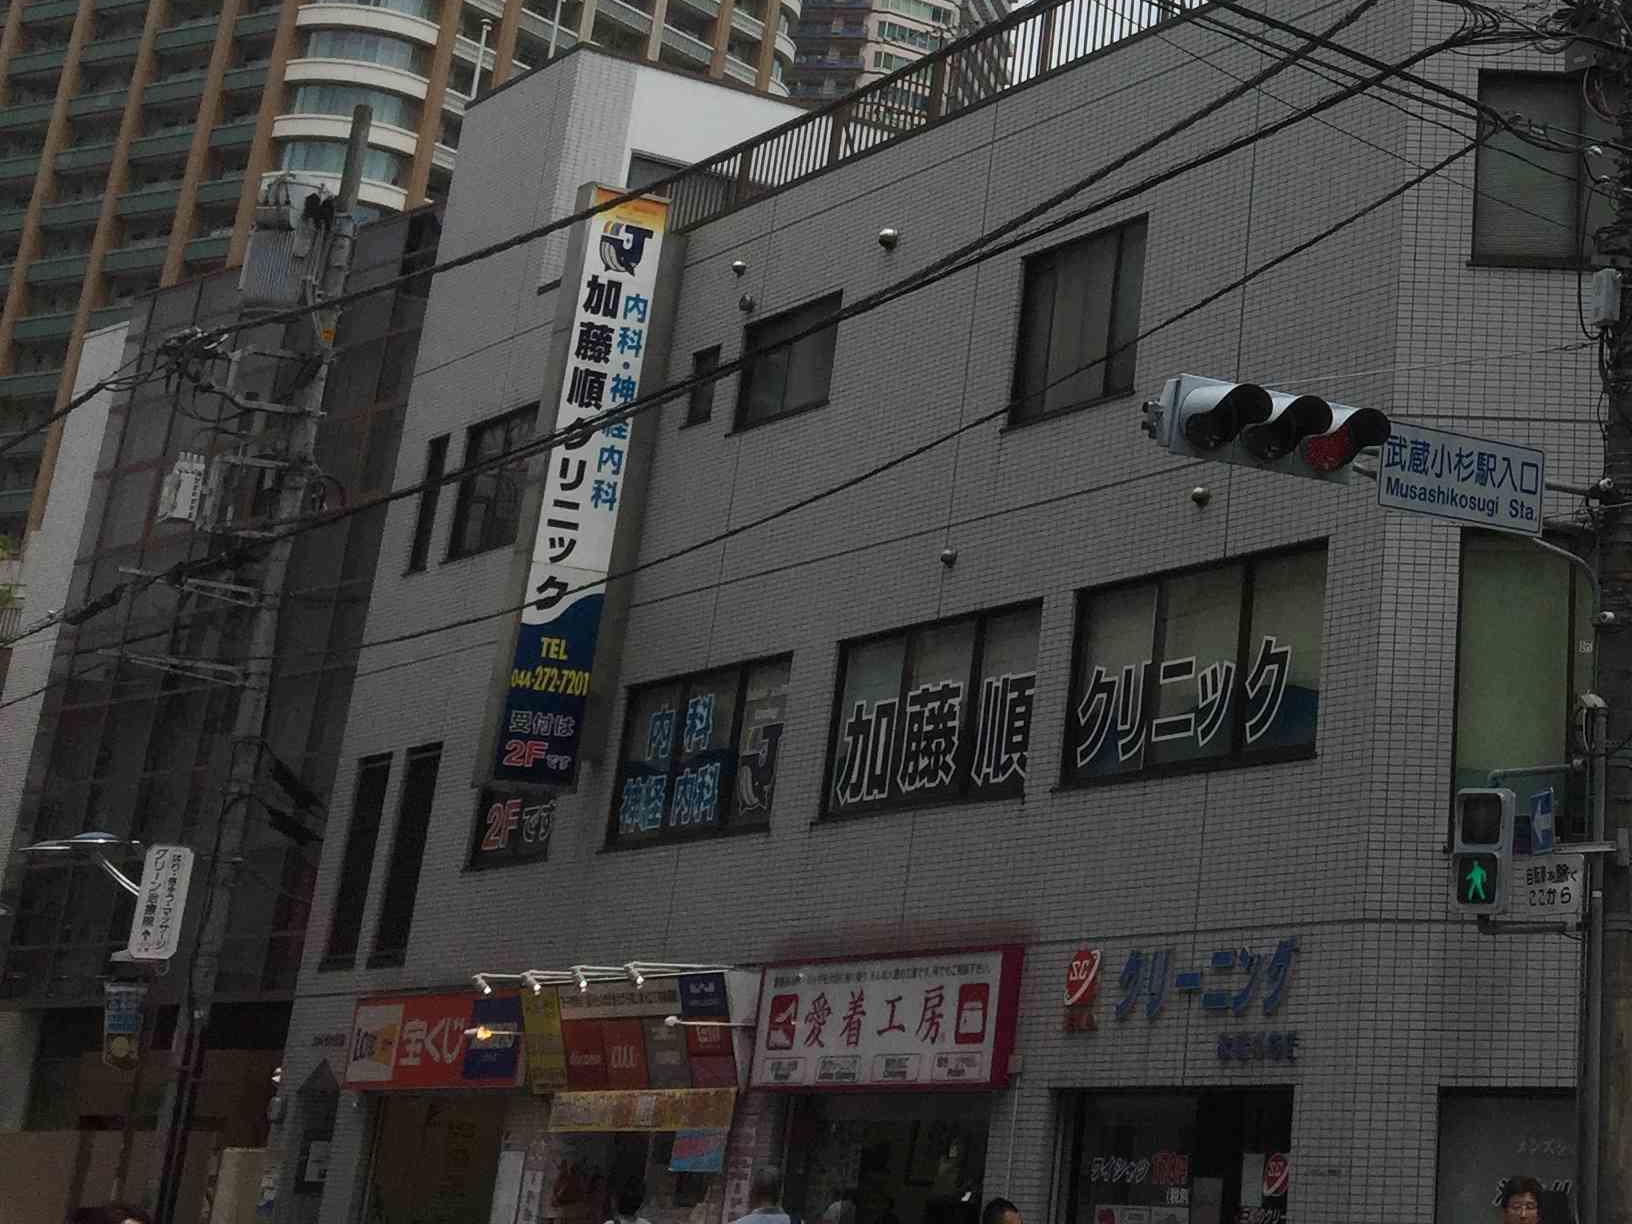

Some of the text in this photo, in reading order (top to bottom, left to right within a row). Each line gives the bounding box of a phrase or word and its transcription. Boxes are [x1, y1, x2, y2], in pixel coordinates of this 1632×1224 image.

[537, 275, 622, 610] 加藤順クリニック
[1384, 434, 1540, 495] 武蔵小杉駅入口
[1385, 478, 1537, 521] Musashikosugi Sta.
[541, 637, 567, 661] TEL
[511, 668, 591, 695] 044-272-7201
[509, 710, 575, 737] 受付は
[835, 634, 1292, 805] 加藤順 クリニック
[1114, 936, 1298, 1019] クリーニング
[400, 1017, 465, 1066] 宝くじ
[804, 985, 946, 1048] 愛着工房
